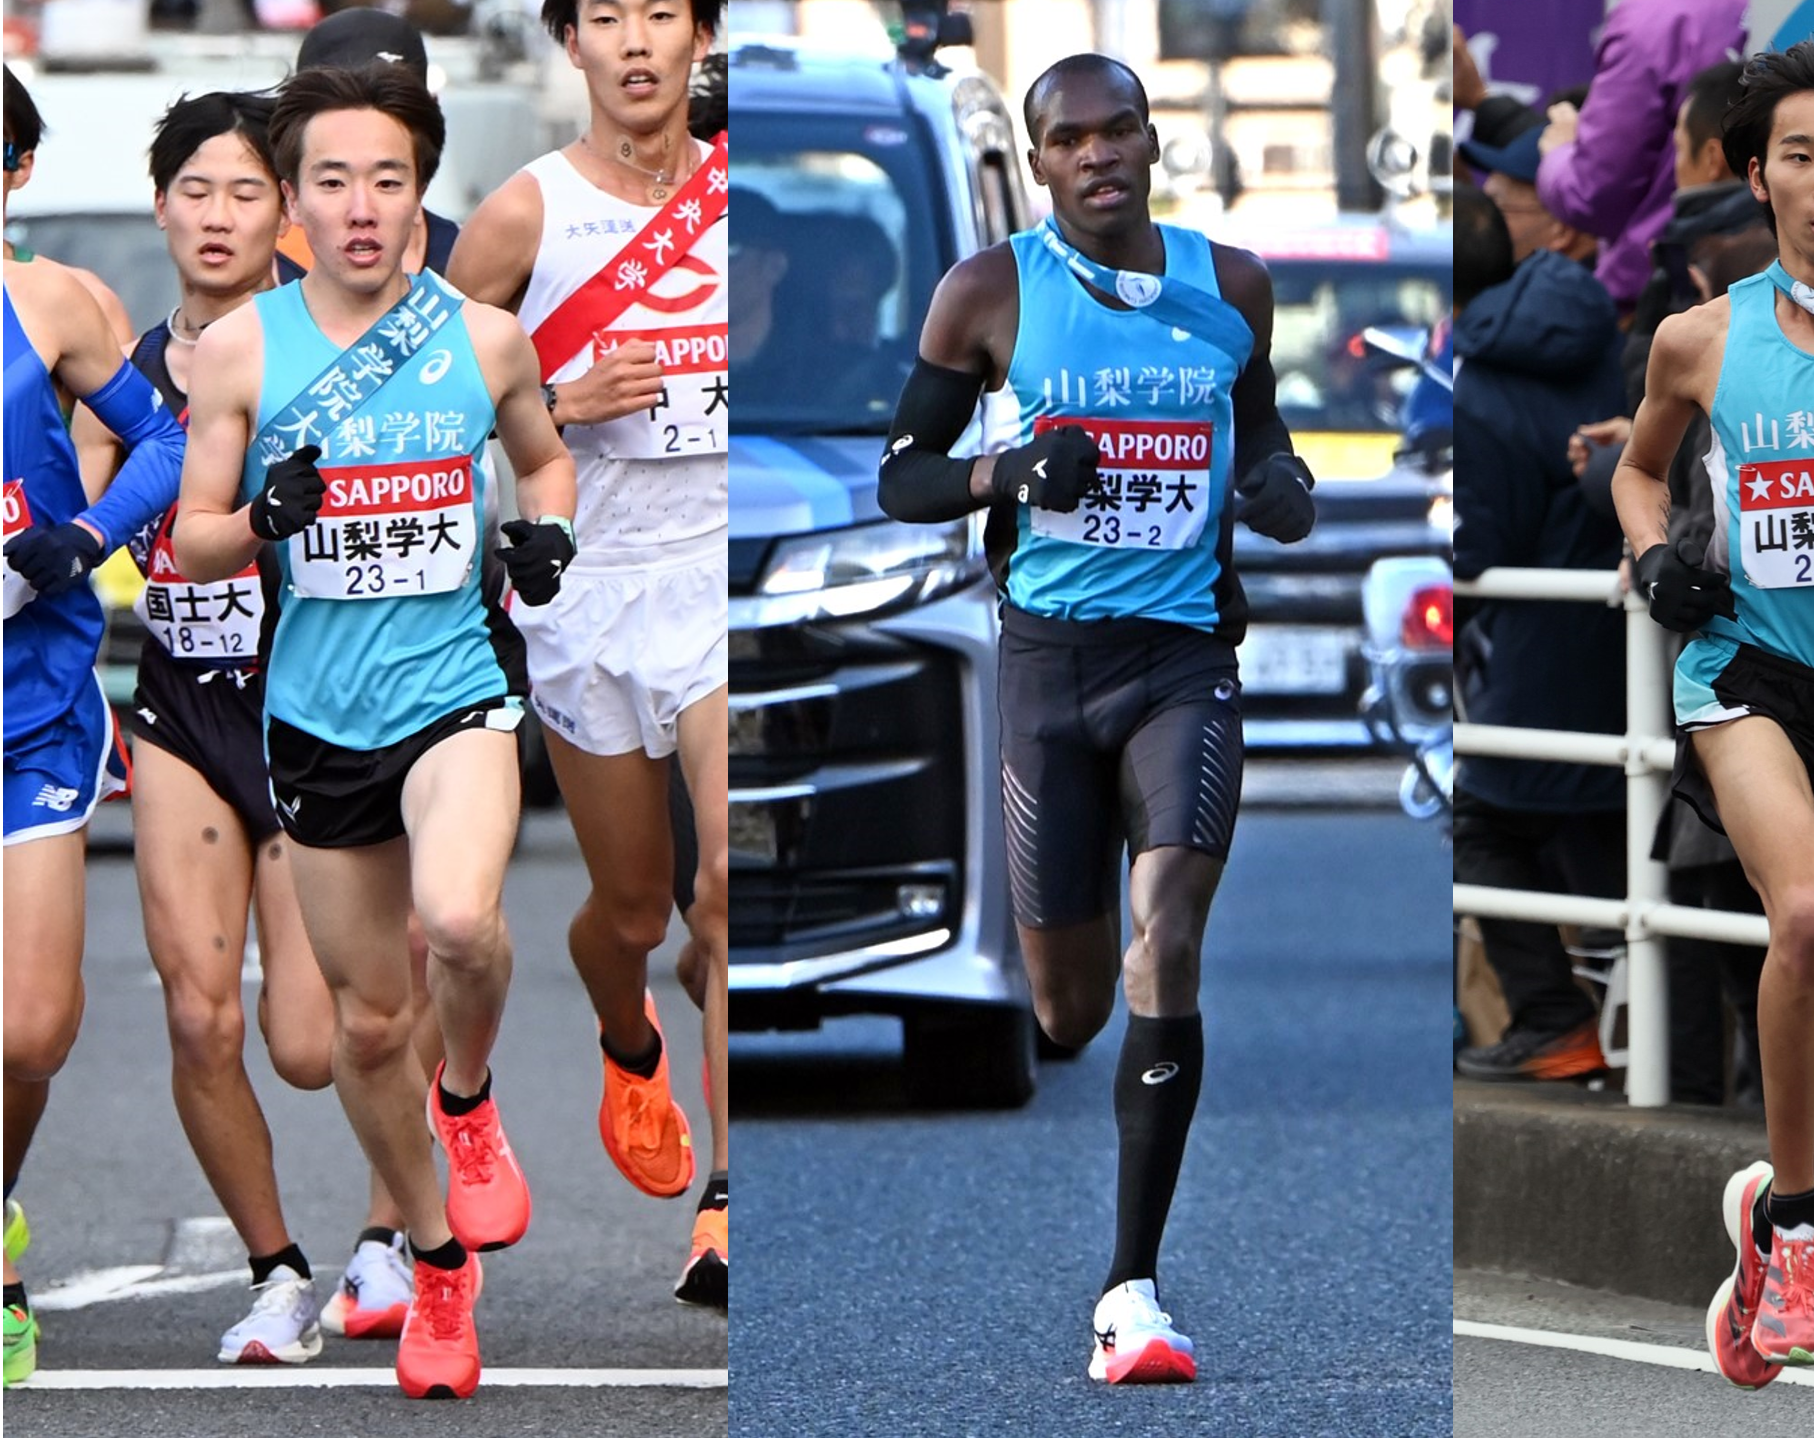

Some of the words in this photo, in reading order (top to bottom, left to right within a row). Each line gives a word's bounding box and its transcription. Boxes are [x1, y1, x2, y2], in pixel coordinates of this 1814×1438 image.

[614, 166, 728, 291] 中央大学
[654, 335, 728, 366] APPO
[261, 286, 449, 466] 山梨学院大学
[1043, 366, 1217, 408] 山梨学院
[1086, 432, 1208, 460] APPORO
[329, 469, 465, 507] SAPPORO
[1085, 473, 1197, 514] 梨学大
[303, 513, 461, 563] 山梨学大
[146, 583, 255, 622] 国士大
